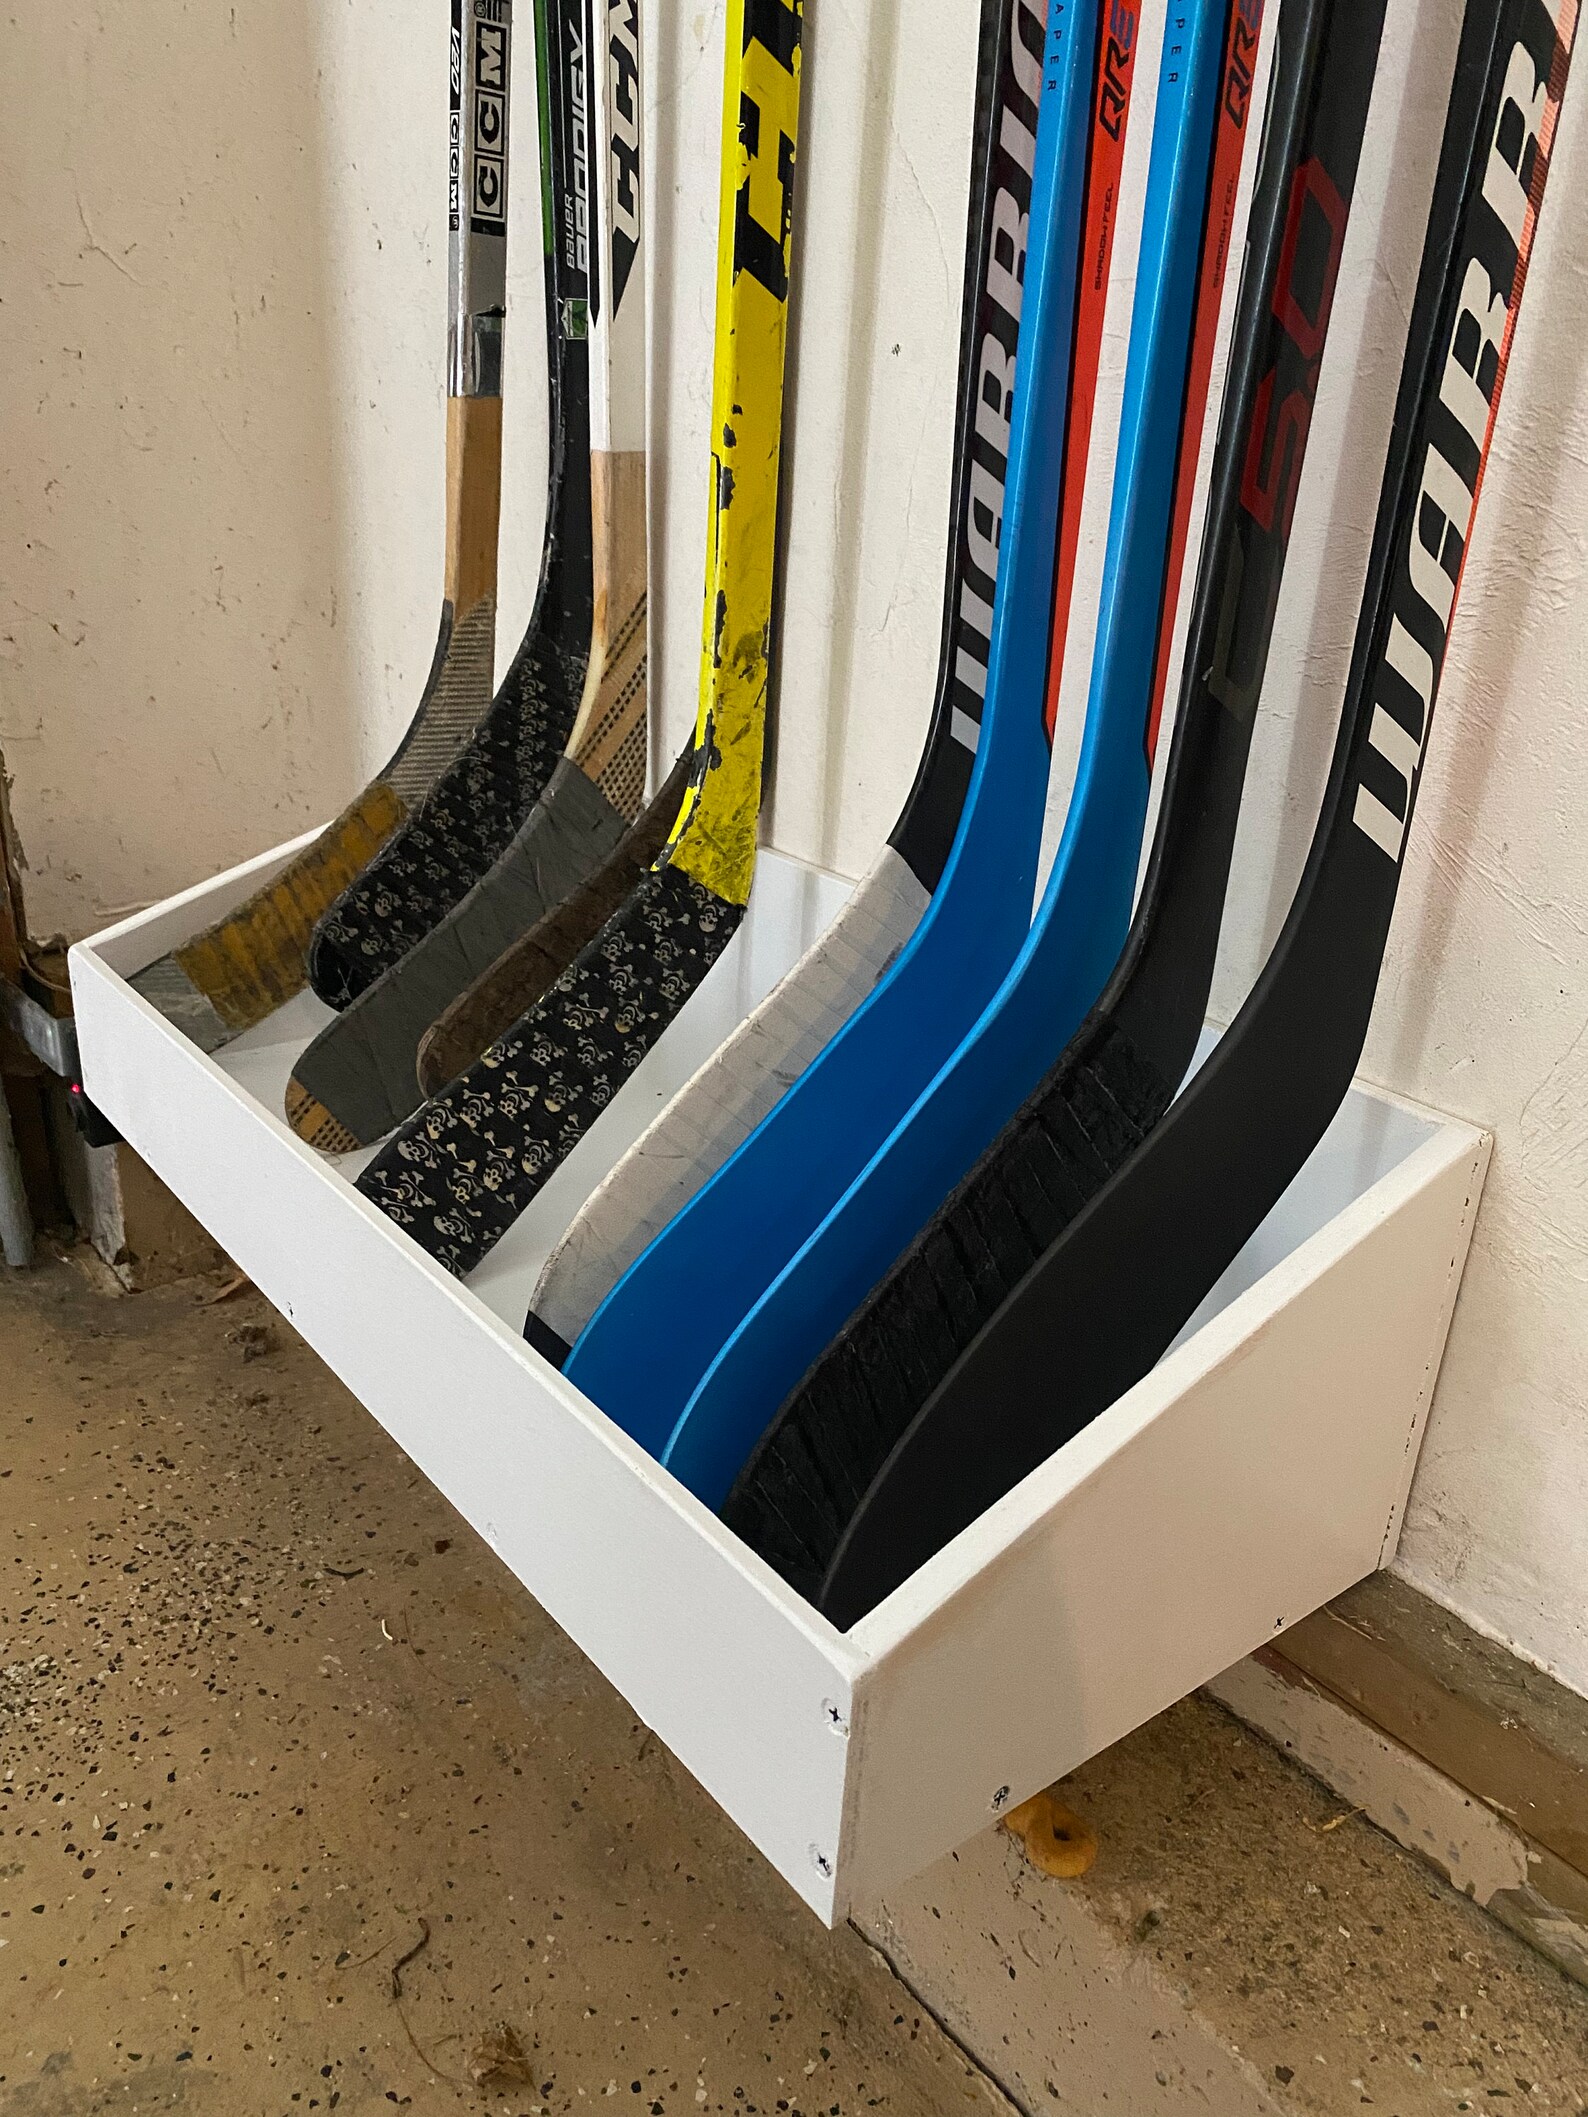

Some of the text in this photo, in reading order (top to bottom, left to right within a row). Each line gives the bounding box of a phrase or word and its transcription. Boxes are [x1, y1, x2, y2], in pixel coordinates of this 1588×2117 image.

[1167, 0, 1185, 83] PER
[450, 113, 459, 212] CCM
[478, 27, 503, 208] CCM
[565, 193, 575, 269] BAUER
